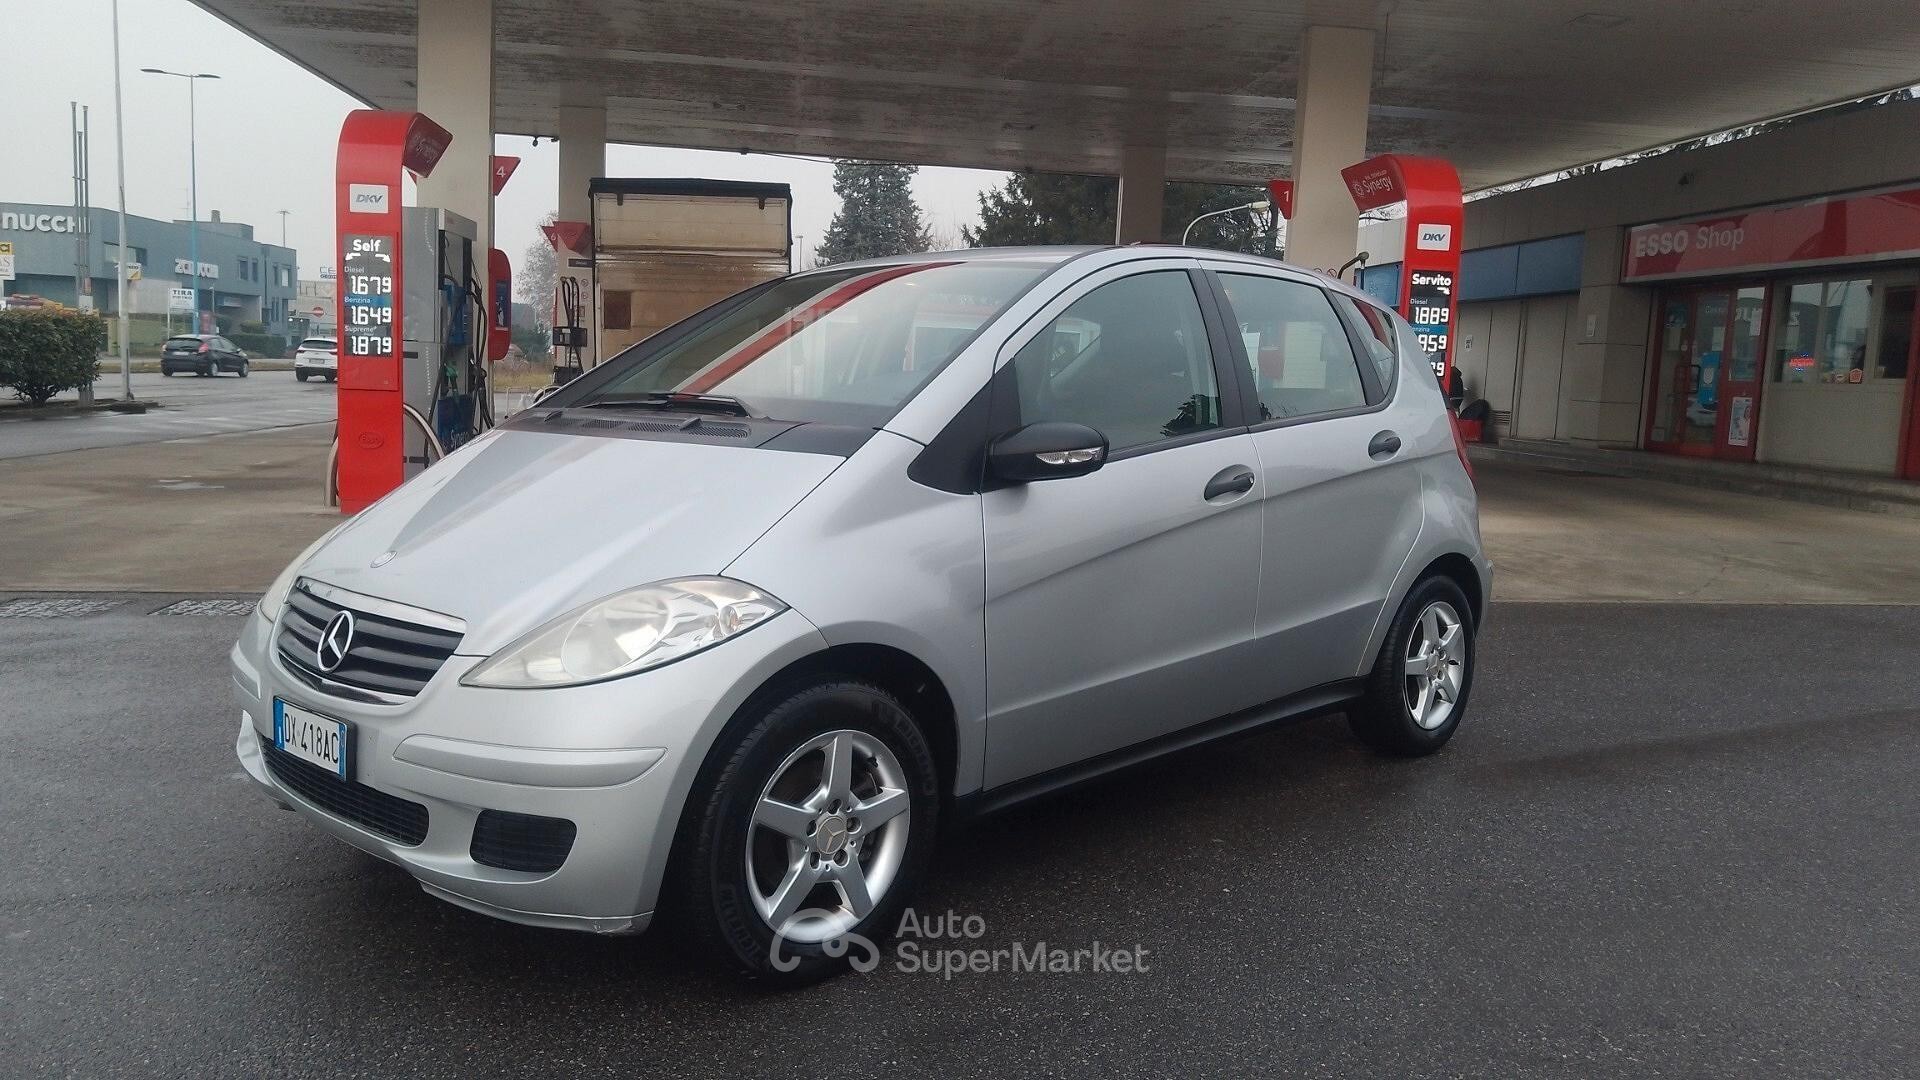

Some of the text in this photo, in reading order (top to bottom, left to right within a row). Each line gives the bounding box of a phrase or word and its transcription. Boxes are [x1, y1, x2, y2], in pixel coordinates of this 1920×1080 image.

[496, 165, 506, 178] 4
[1362, 175, 1394, 196] Synergy
[356, 194, 383, 203] DKV
[1283, 190, 1290, 202] 1
[1422, 233, 1446, 242] DKV
[1636, 226, 1745, 258] ESSO Shop
[352, 238, 382, 252] Self
[1411, 273, 1452, 287] Servito
[344, 296, 371, 304] Benzina
[284, 712, 297, 747] DX
[301, 721, 339, 764] 418AC
